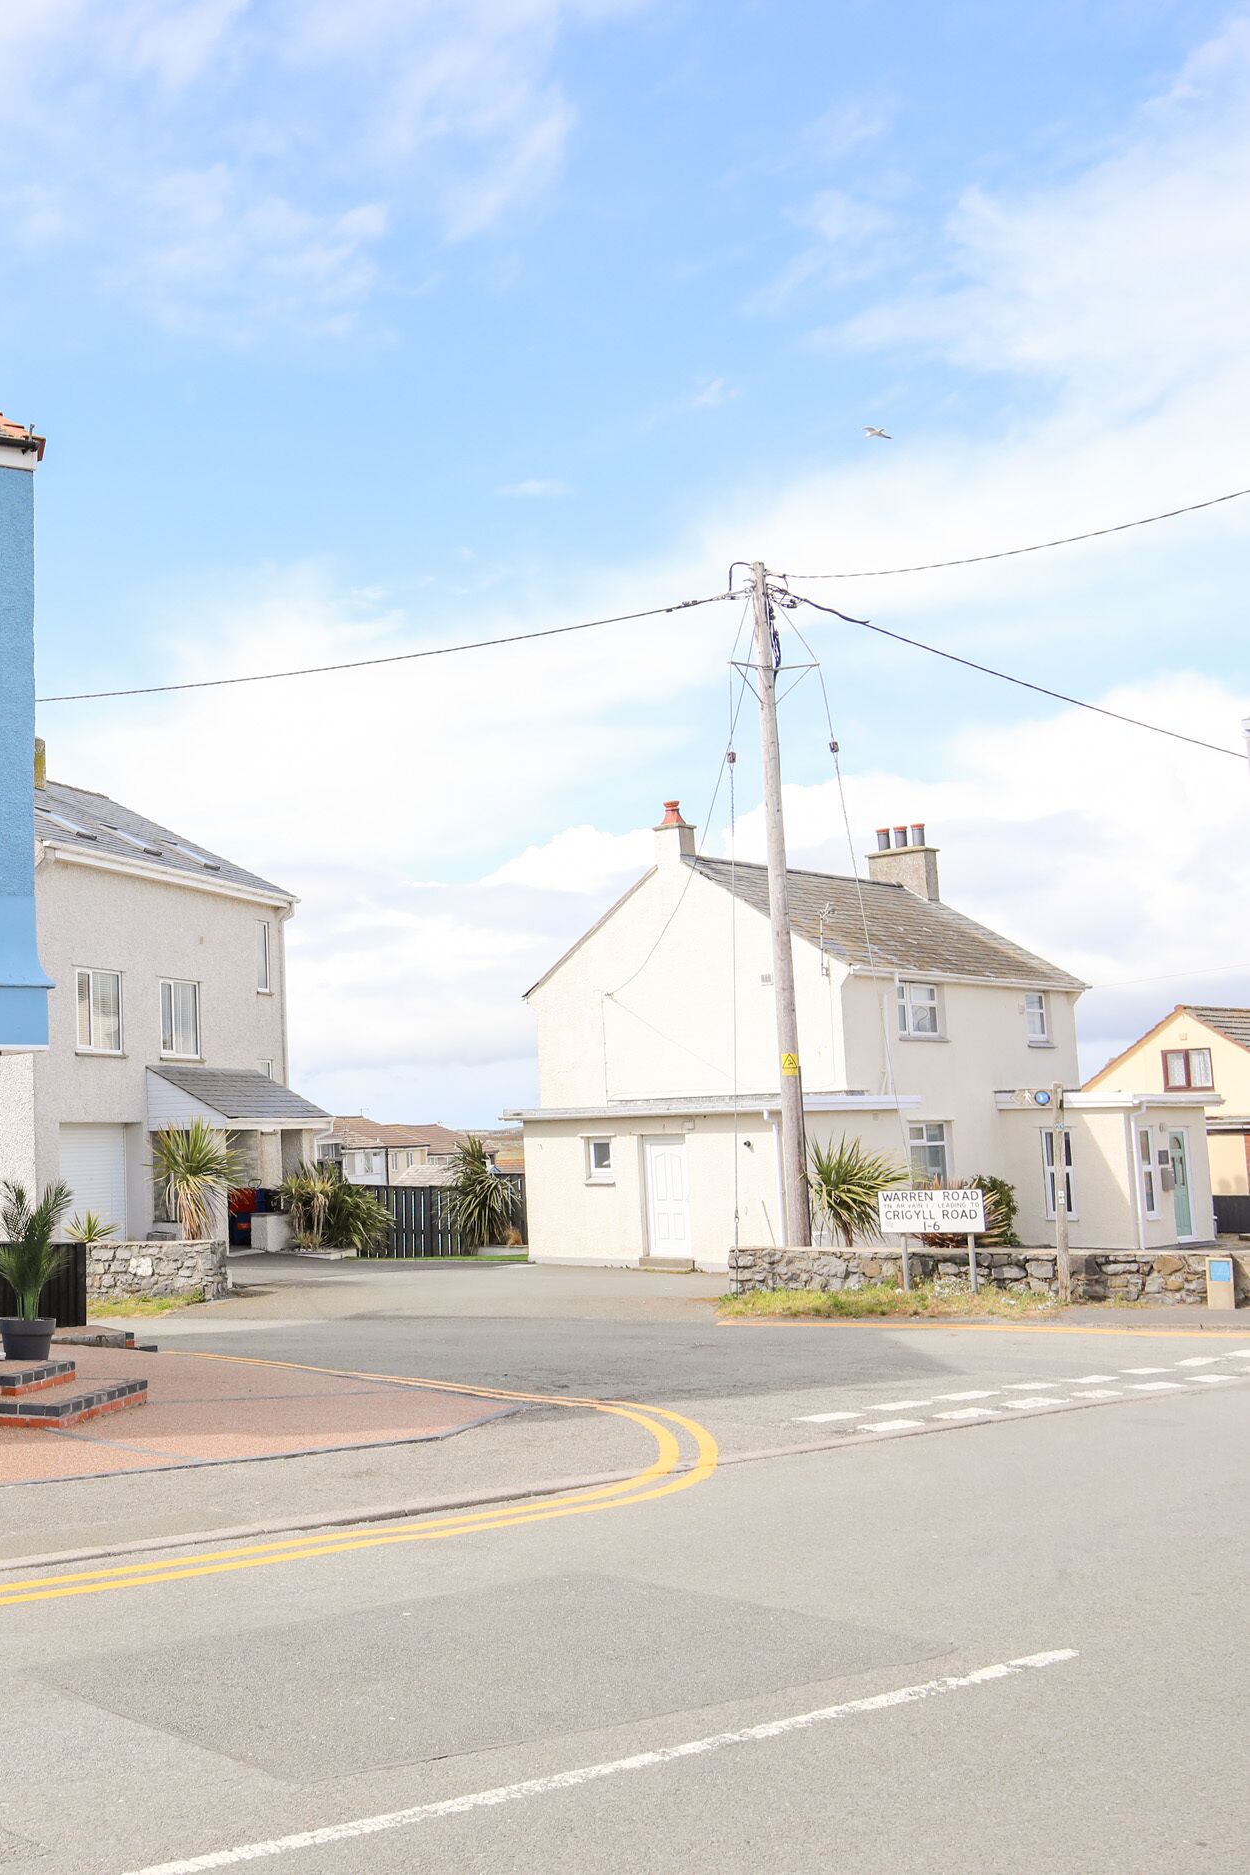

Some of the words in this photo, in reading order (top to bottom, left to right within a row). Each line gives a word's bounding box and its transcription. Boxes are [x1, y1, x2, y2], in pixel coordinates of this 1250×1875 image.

[882, 1192, 933, 1202] WARREN
[942, 1191, 979, 1201] ROAD
[885, 1209, 936, 1220] CRIGYLL
[942, 1209, 978, 1220] ROAD
[923, 1221, 941, 1231] 1-6
